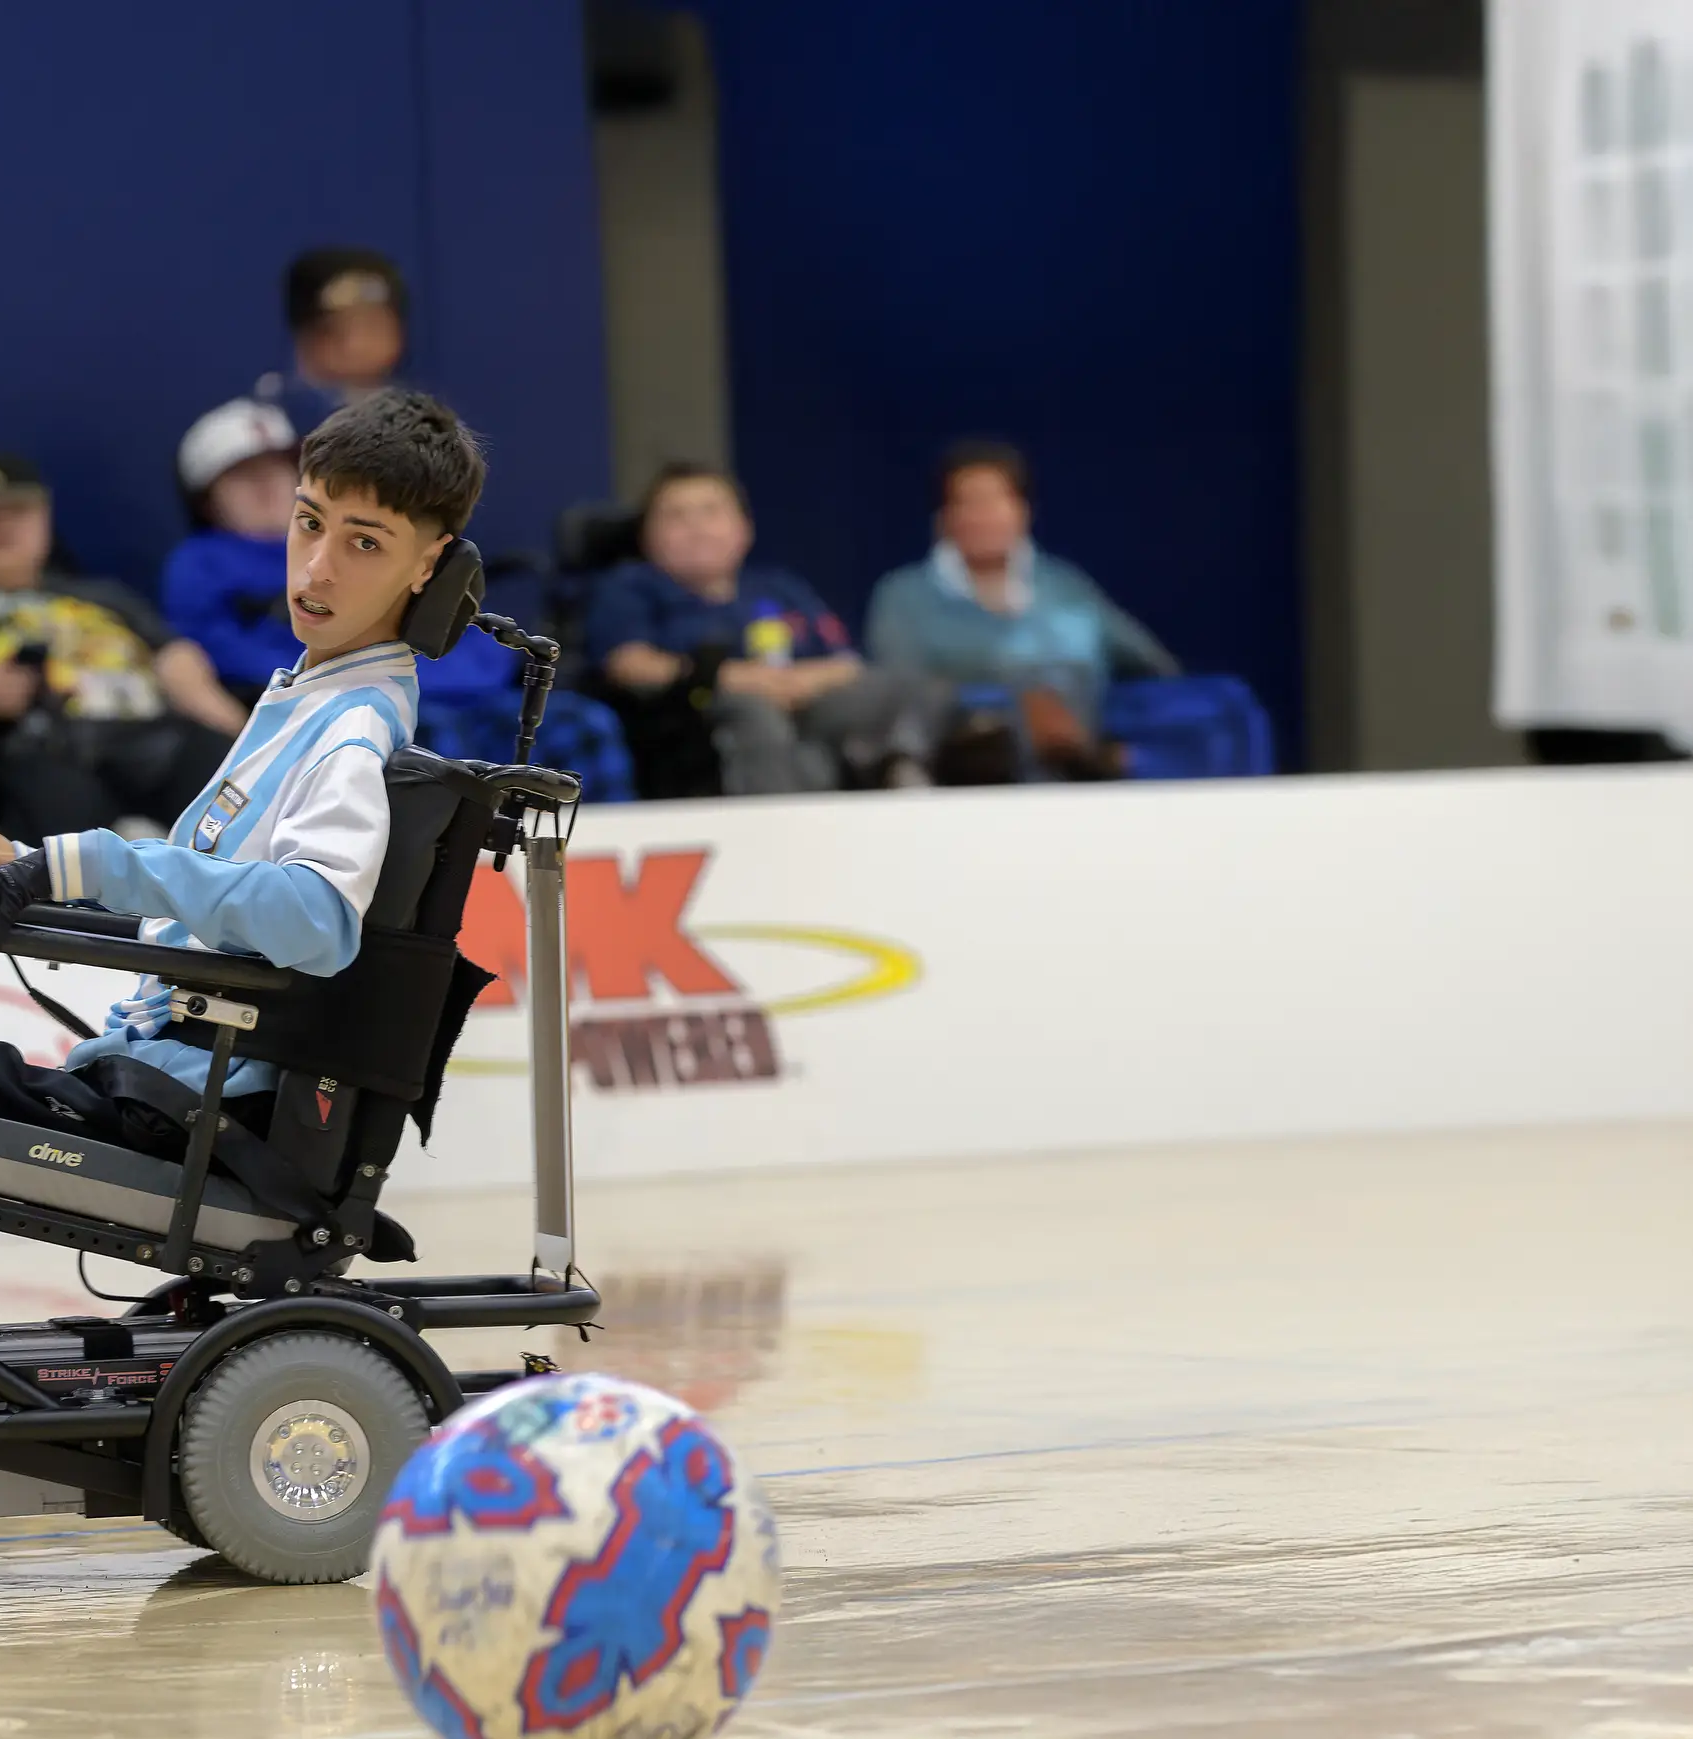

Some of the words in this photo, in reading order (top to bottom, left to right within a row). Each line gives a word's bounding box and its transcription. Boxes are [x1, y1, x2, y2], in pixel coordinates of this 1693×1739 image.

[28, 1142, 83, 1167] drive
[37, 1368, 92, 1379] STRIKE
[107, 1375, 157, 1385] FORCE
